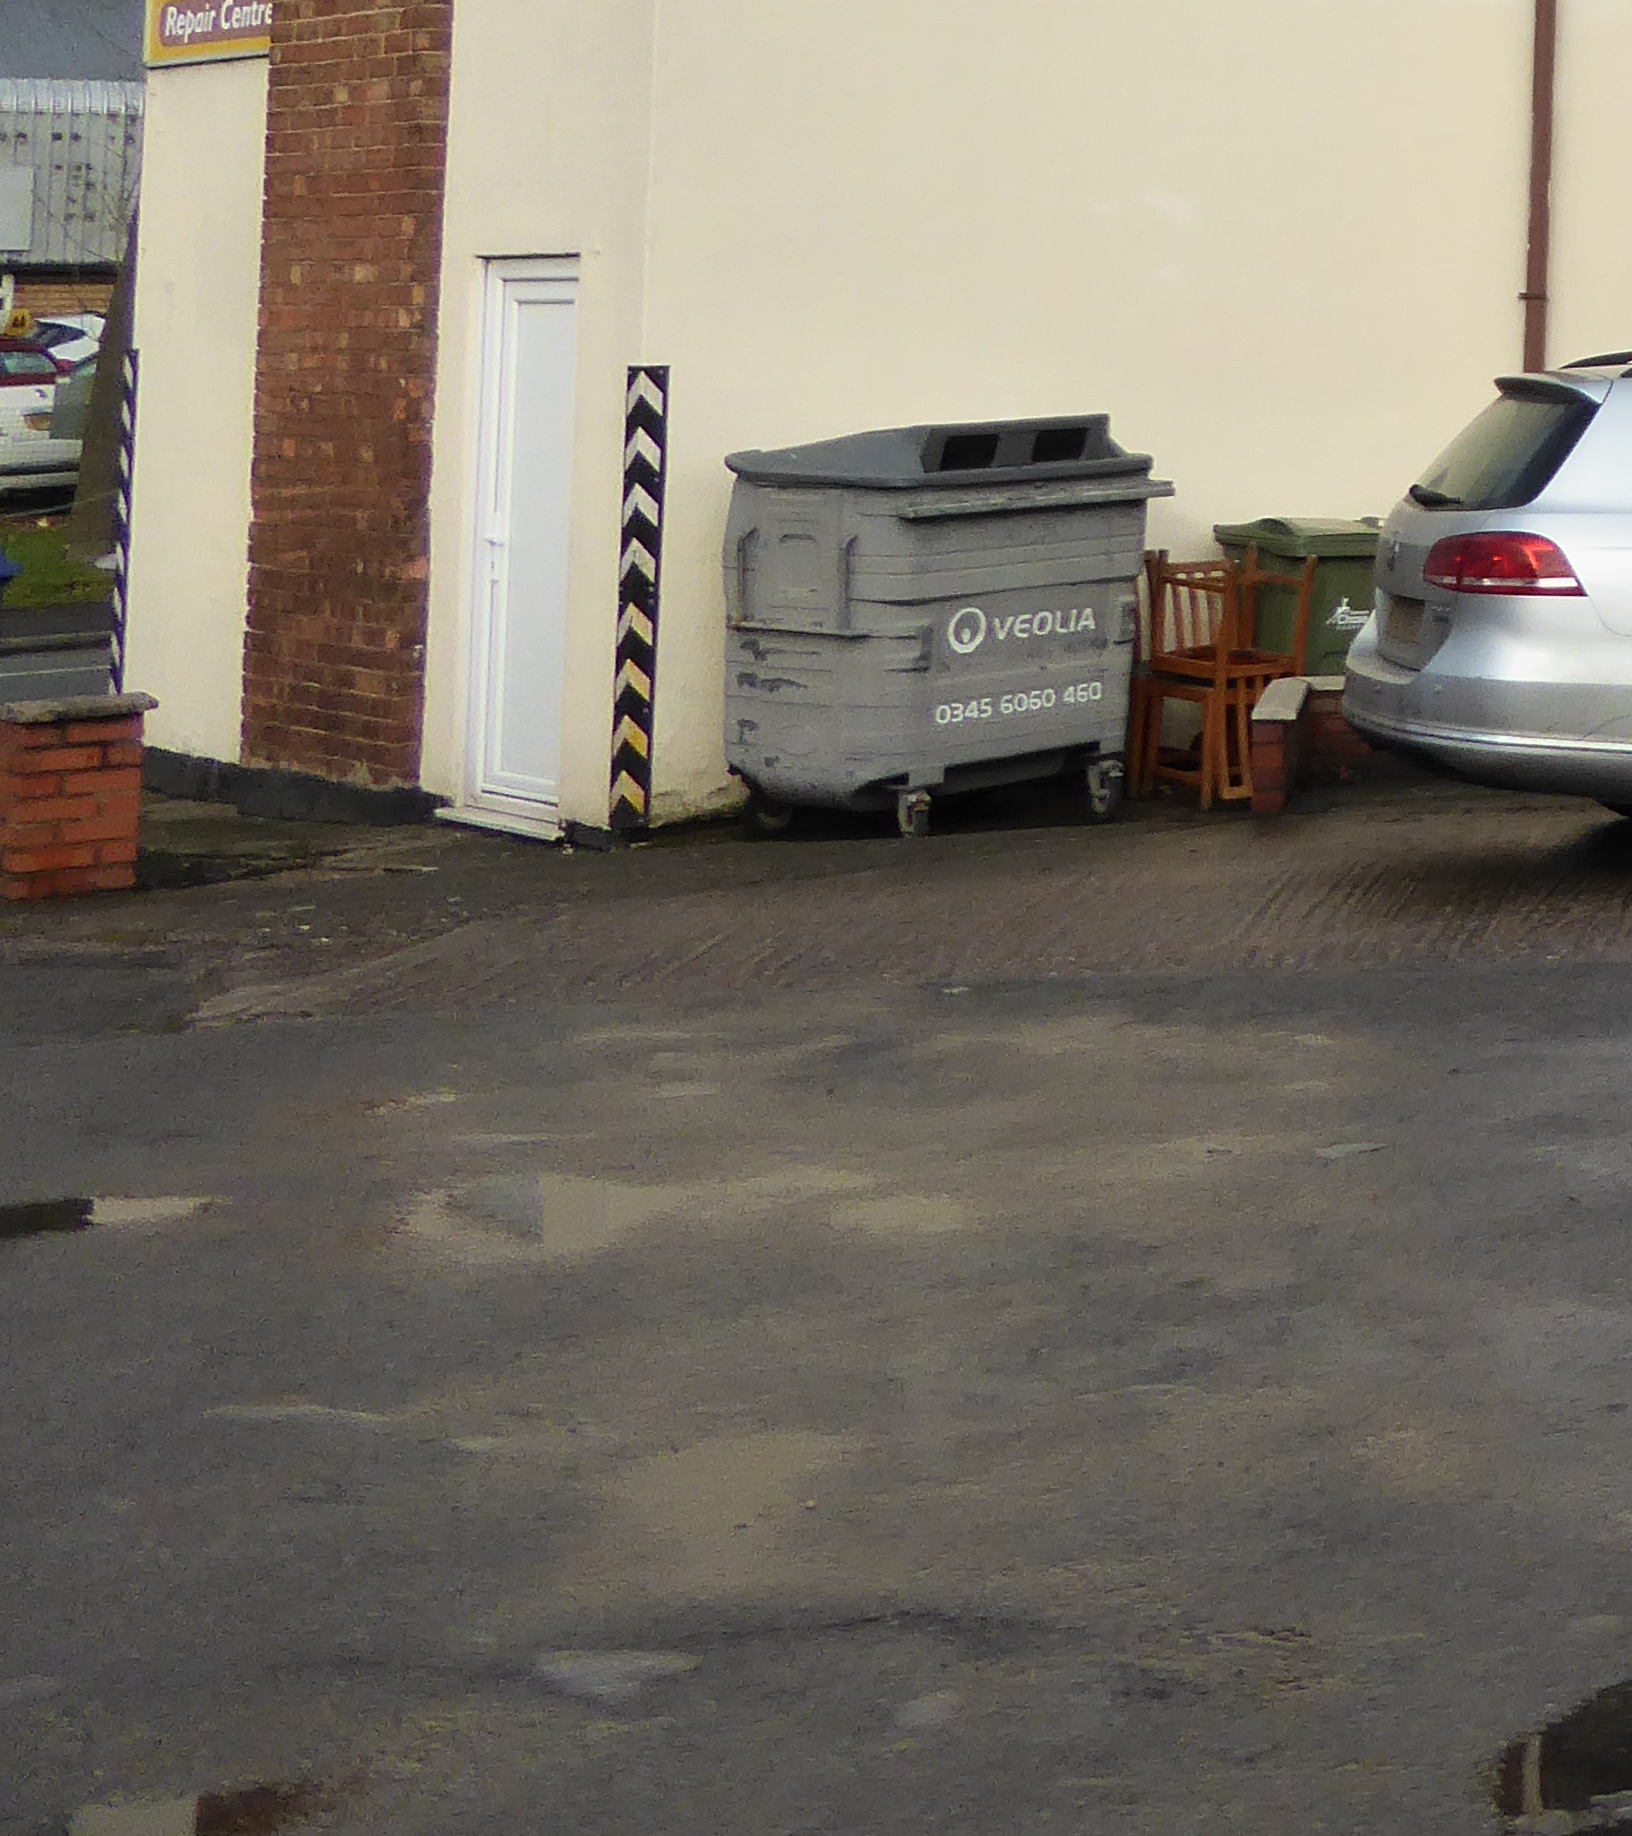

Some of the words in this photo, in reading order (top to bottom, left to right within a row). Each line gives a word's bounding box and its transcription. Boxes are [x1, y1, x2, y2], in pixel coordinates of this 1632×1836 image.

[165, 3, 217, 44] Repair
[992, 607, 1096, 641] VEOLIA
[934, 697, 993, 724] 0345
[1000, 688, 1056, 715] 6060
[1062, 681, 1102, 704] 460
